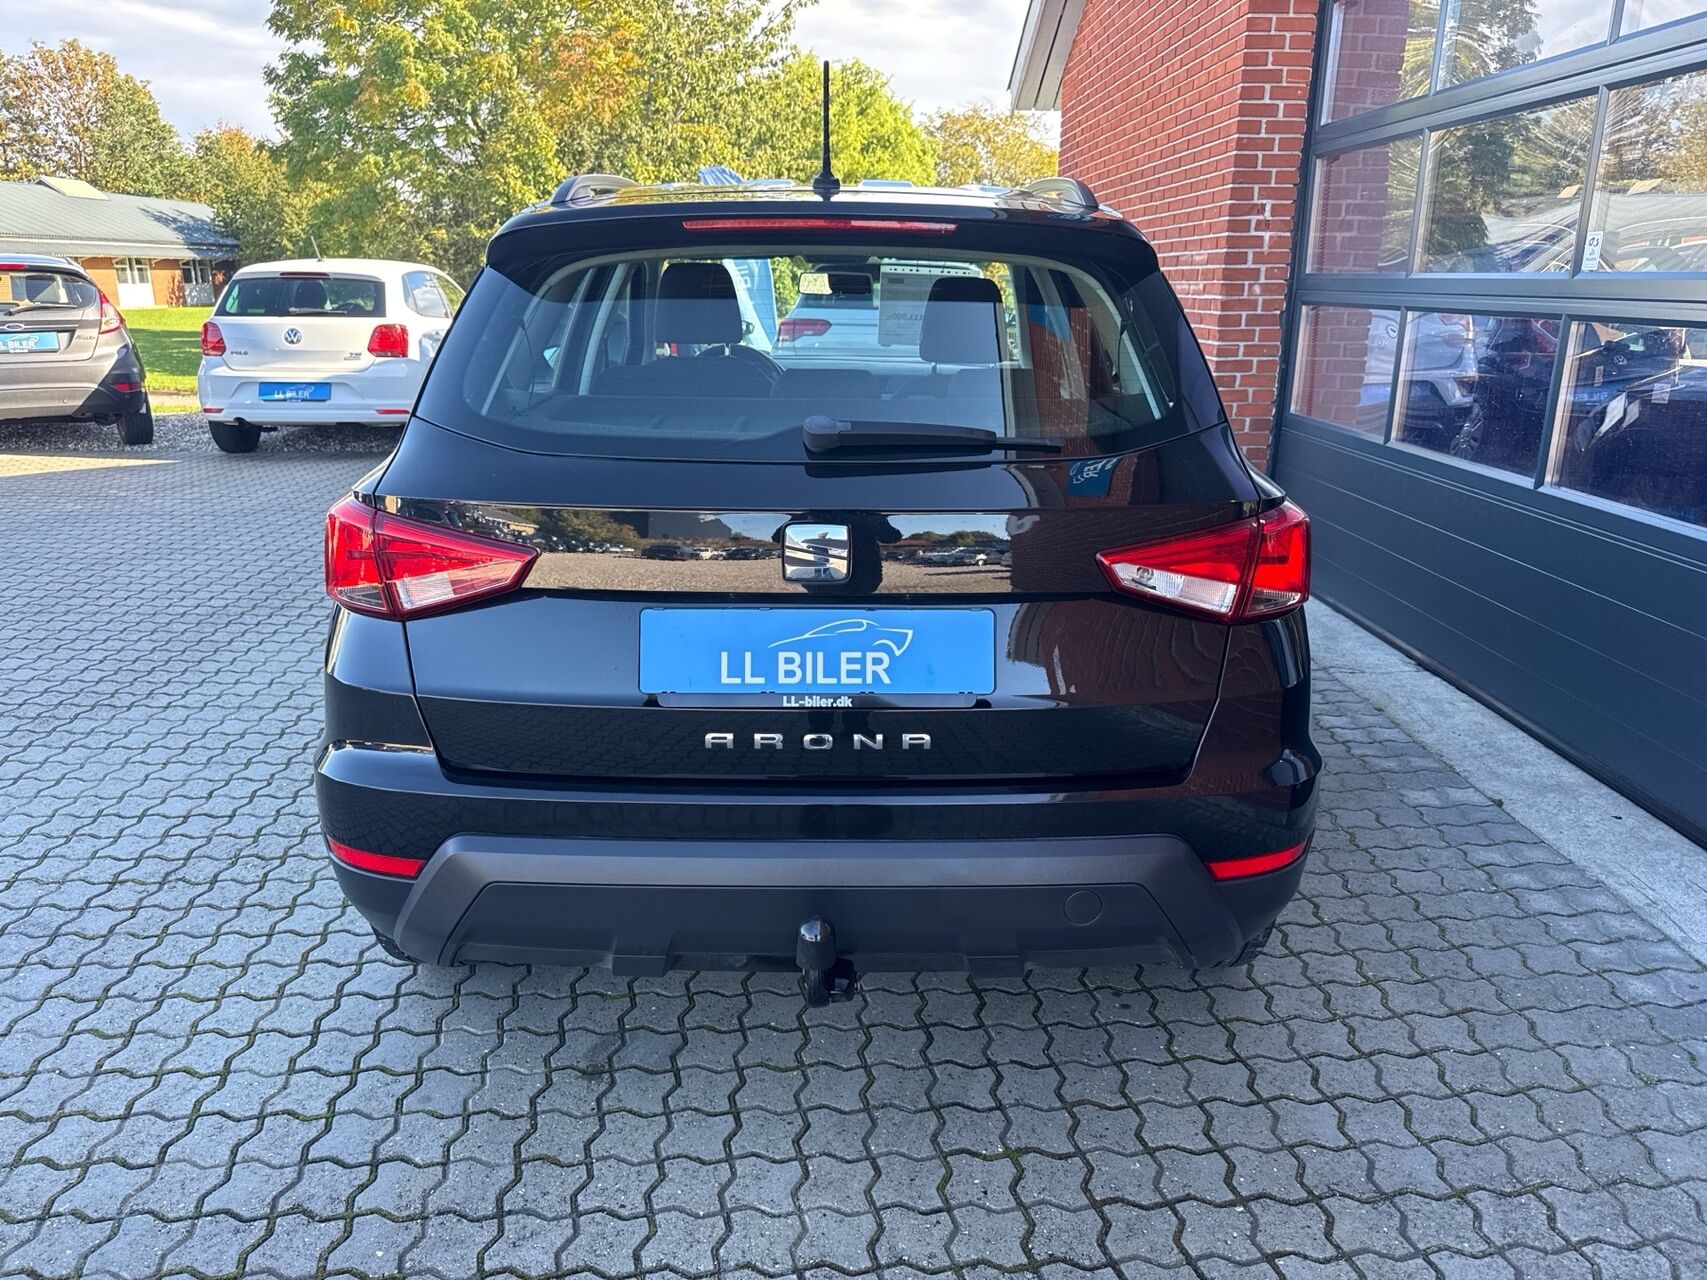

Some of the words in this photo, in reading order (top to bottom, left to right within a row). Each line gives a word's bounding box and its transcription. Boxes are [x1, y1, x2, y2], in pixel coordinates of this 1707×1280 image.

[286, 390, 310, 398] BILER
[720, 651, 765, 684] LL
[778, 651, 891, 684] BILER
[782, 695, 853, 708] LL-biler.dk
[704, 732, 931, 750] ARONA
